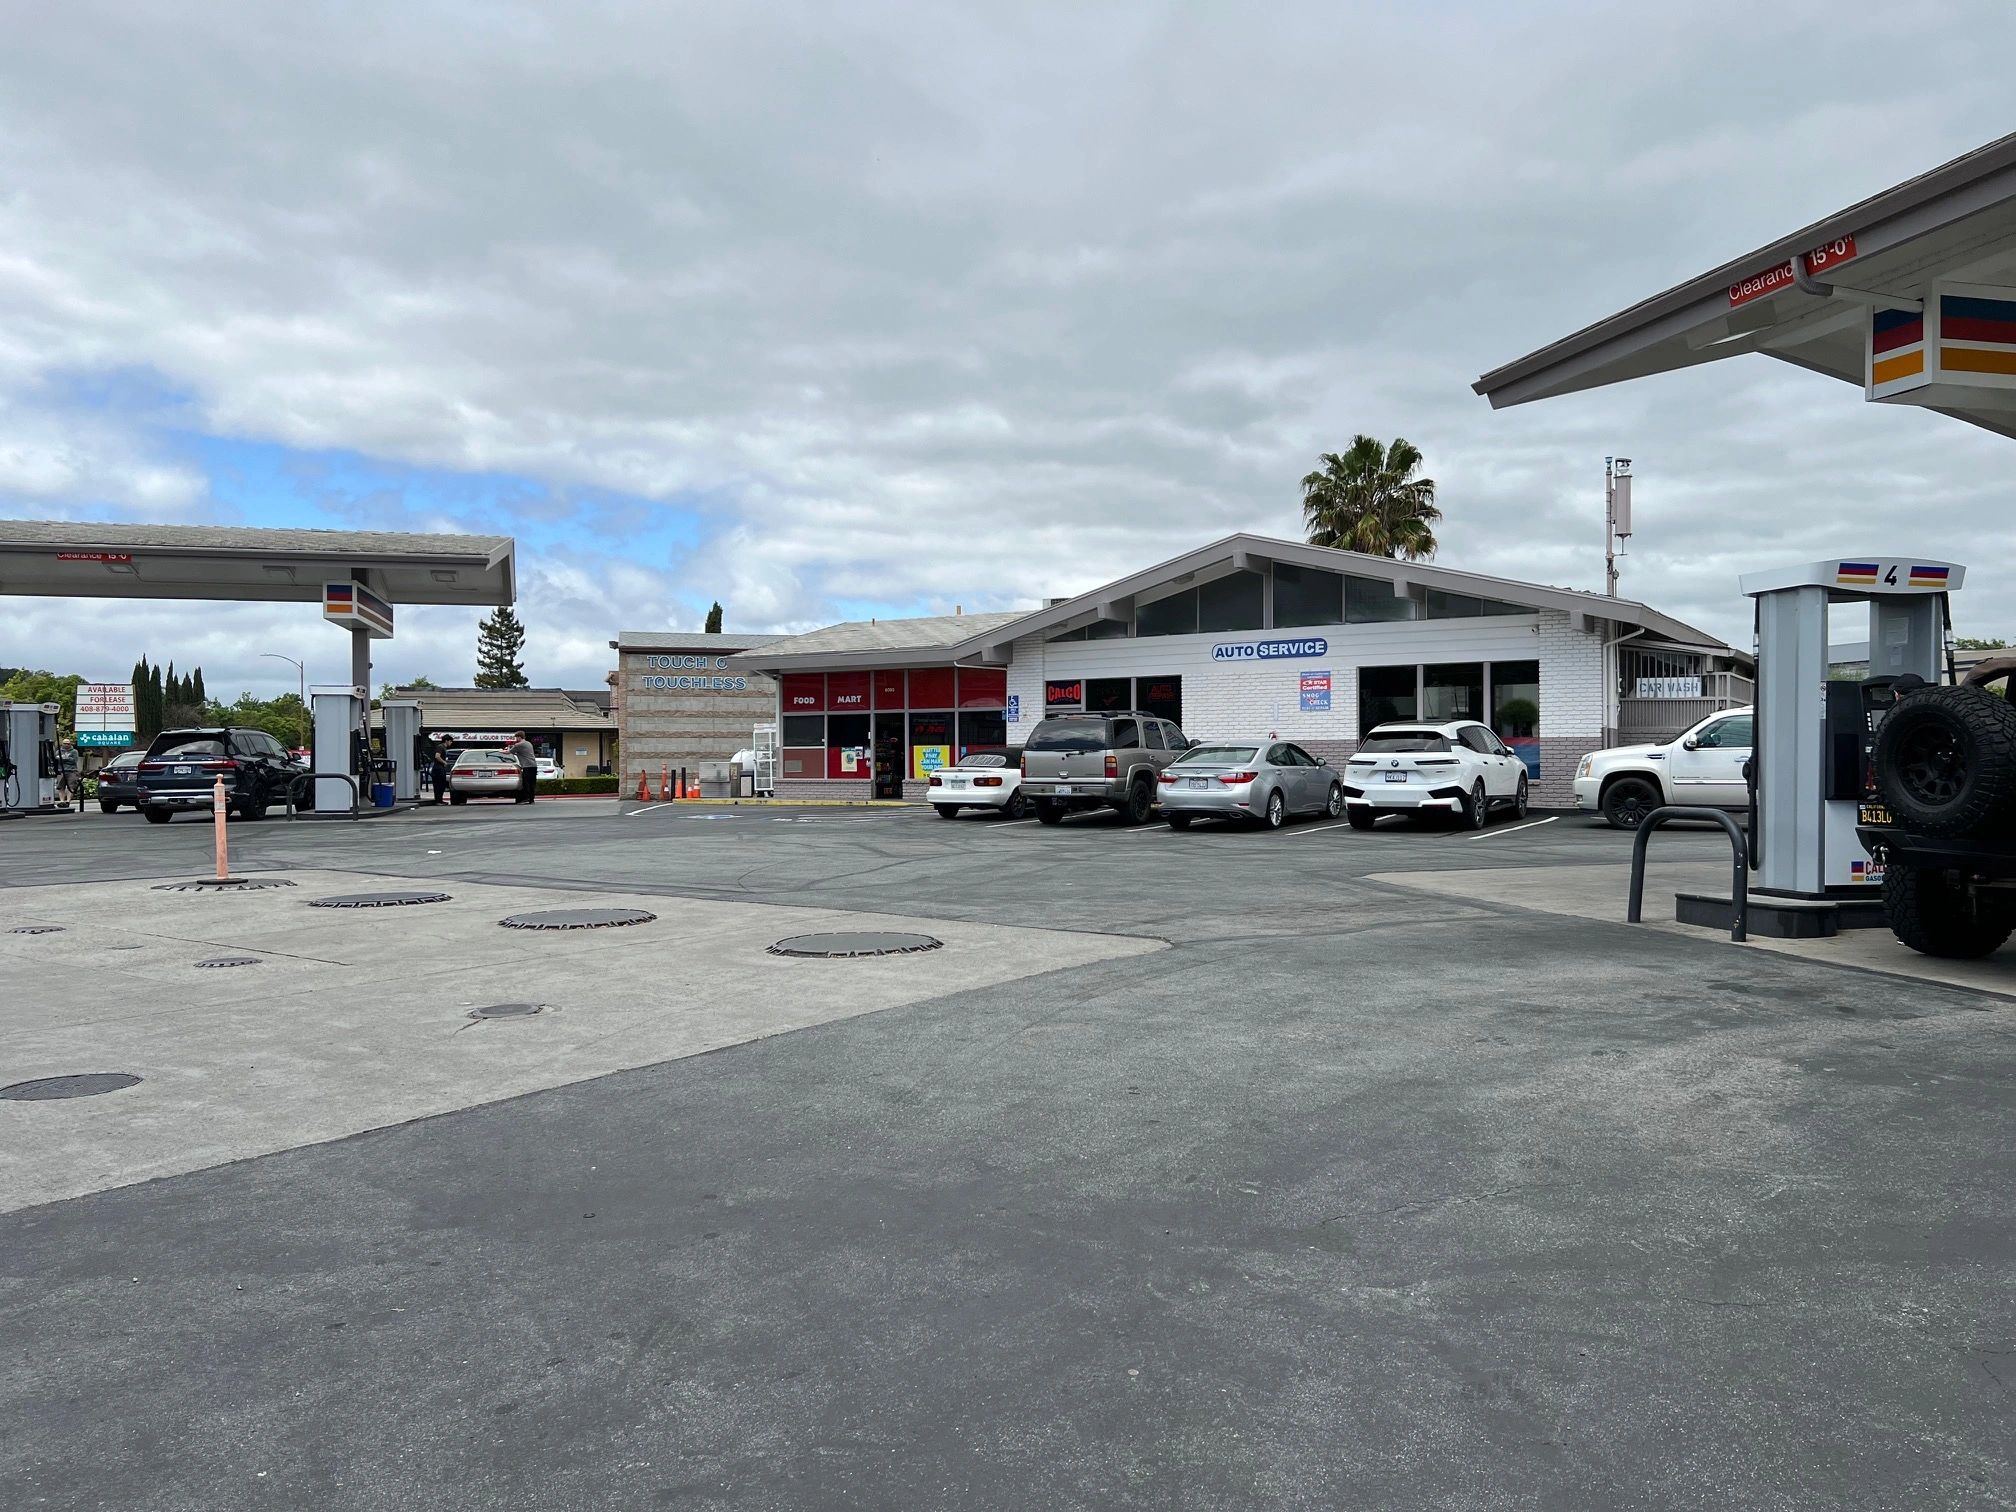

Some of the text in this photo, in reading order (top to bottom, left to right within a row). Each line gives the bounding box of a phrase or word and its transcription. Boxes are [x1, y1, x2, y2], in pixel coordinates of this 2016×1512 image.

[1728, 264, 1793, 300] Clearanc
[1884, 565, 1898, 586] 4
[1215, 642, 1325, 658] AUTO SERVICE
[647, 656, 728, 669] TOUCH O
[642, 676, 747, 690] TOUCHLESS
[1640, 682, 1698, 692] CAR WASH
[837, 695, 862, 703] MART
[1048, 684, 1081, 701] CALCO
[92, 733, 130, 741] cahalan
[1866, 861, 1885, 875] CAL
